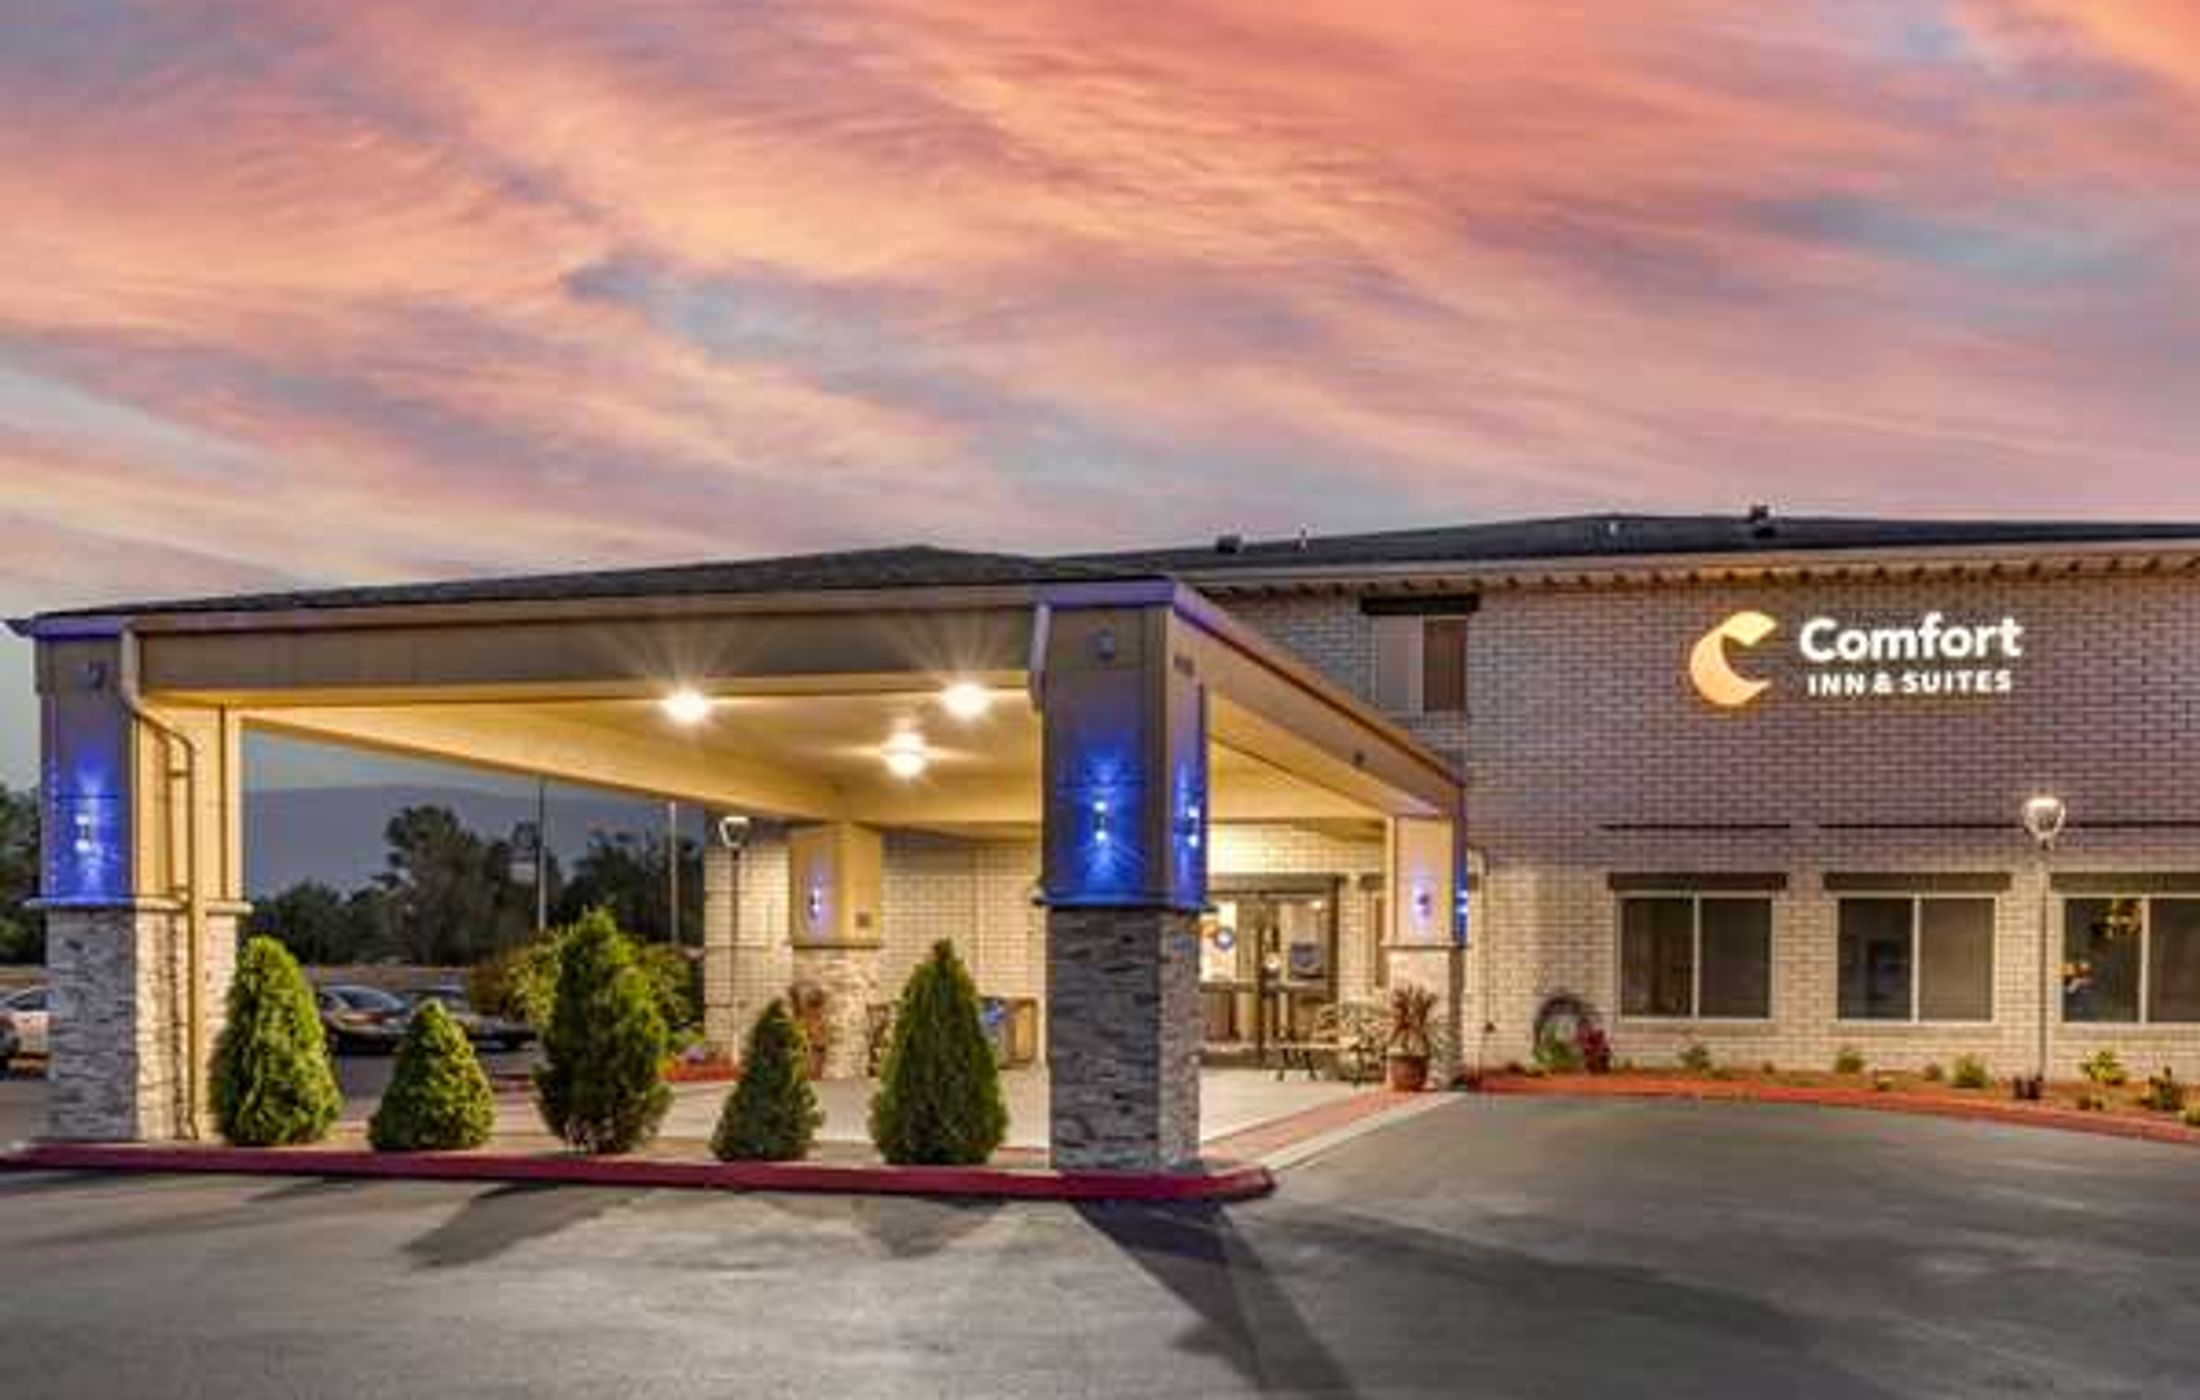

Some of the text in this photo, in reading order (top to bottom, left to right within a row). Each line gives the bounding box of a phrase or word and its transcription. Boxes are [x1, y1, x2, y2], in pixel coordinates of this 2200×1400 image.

[1799, 611, 2024, 662] Comfort
[1808, 669, 2013, 696] INN & SUITES
